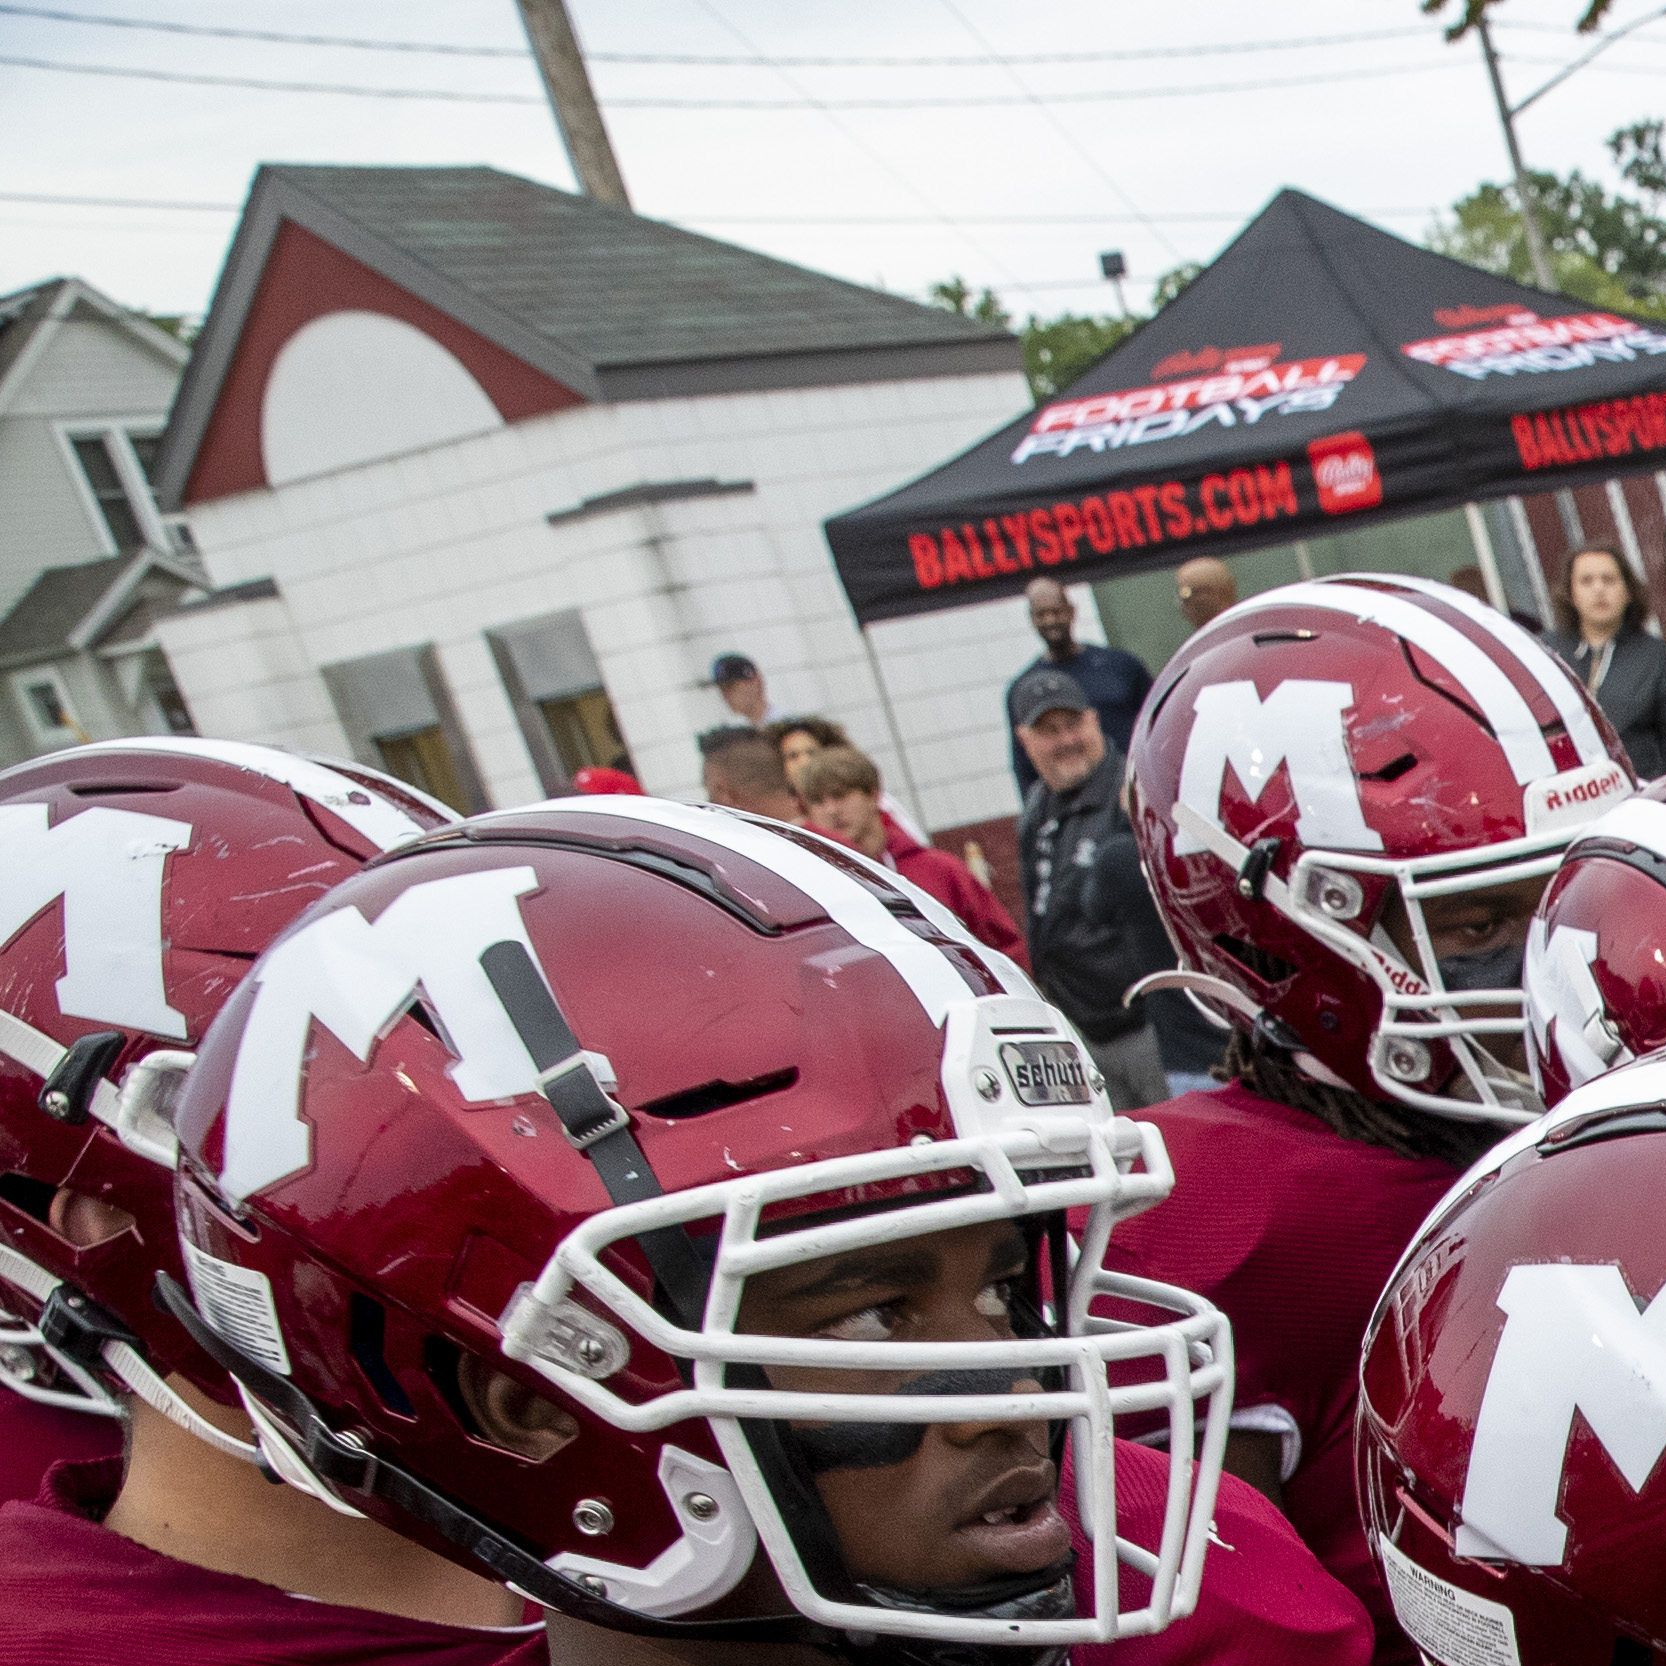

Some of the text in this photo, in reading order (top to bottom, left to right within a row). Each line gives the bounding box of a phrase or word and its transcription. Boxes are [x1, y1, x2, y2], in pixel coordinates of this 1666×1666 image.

[1011, 382, 1345, 465] FRIDAYS
[1036, 358, 1356, 434] FOOTBALL
[907, 461, 1298, 590] BALLYSPORTS.COM
[1173, 680, 1384, 857] M
[216, 865, 617, 1201] M
[1016, 1053, 1087, 1088] schutt
